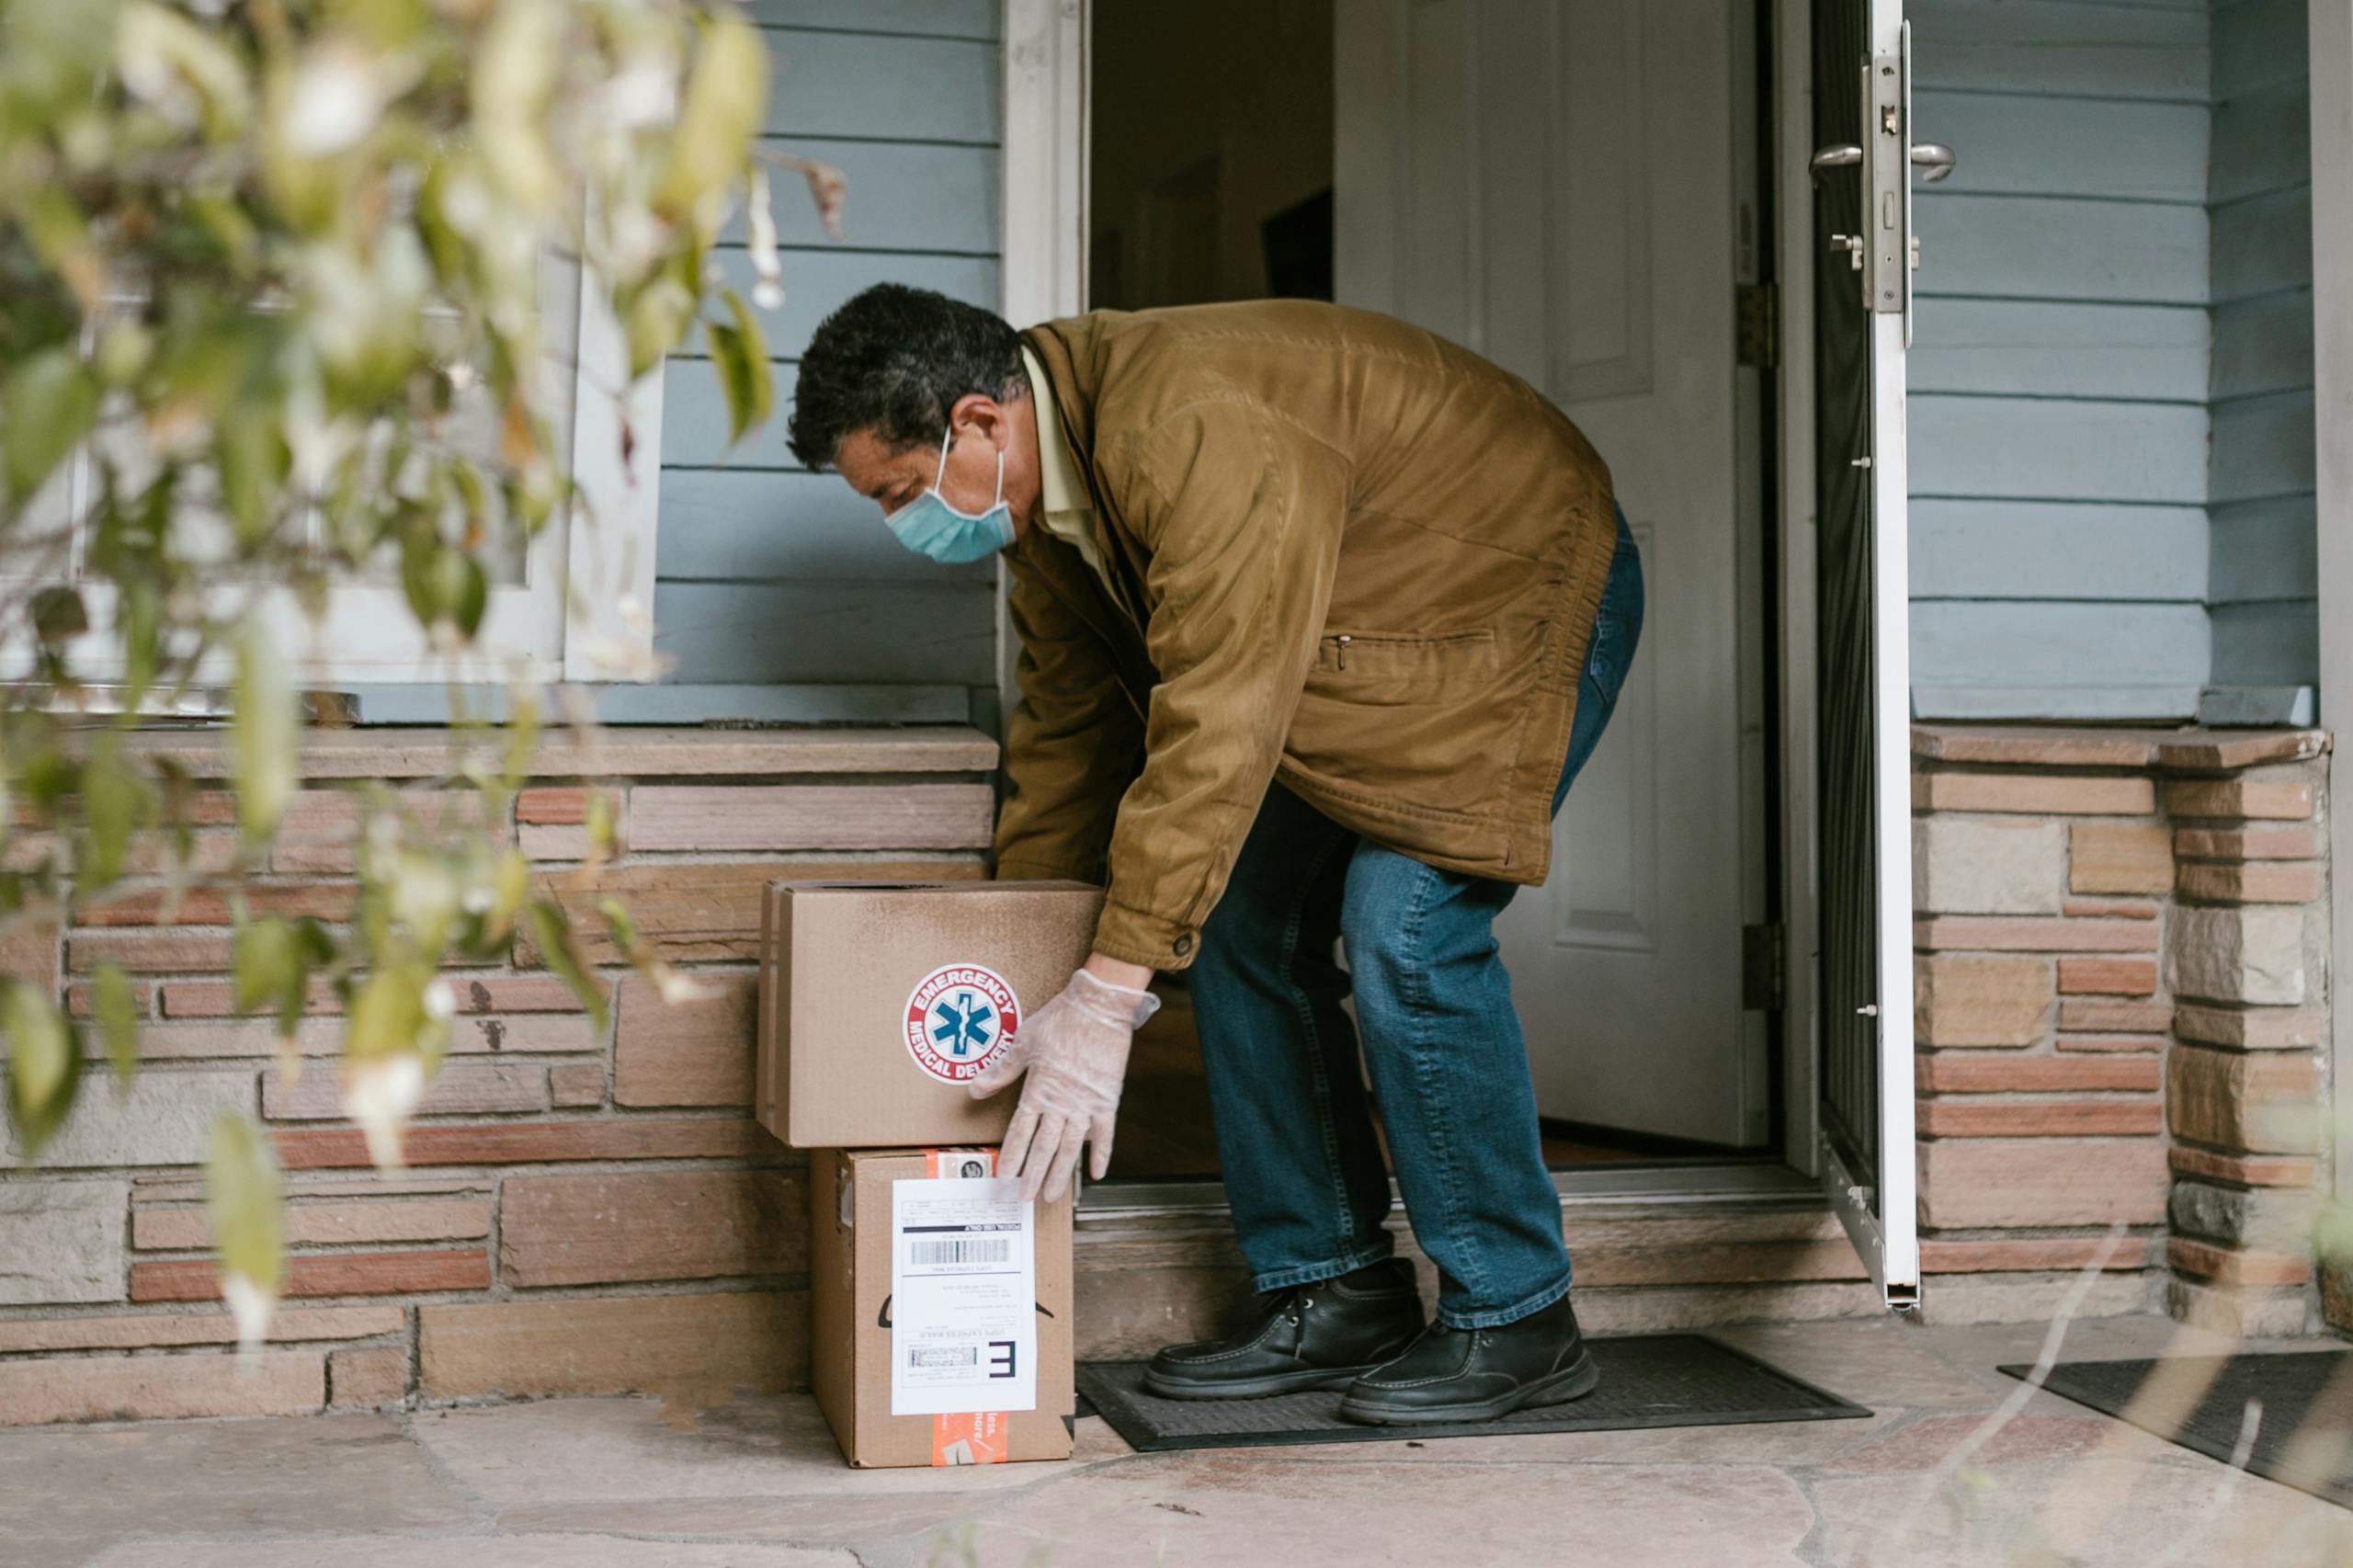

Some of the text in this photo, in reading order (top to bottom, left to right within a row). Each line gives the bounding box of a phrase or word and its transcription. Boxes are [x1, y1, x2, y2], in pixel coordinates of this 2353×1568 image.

[914, 970, 1015, 1014] EMERGENCY
[909, 1020, 951, 1077] MEDICAL
[989, 1341, 1016, 1378] E
